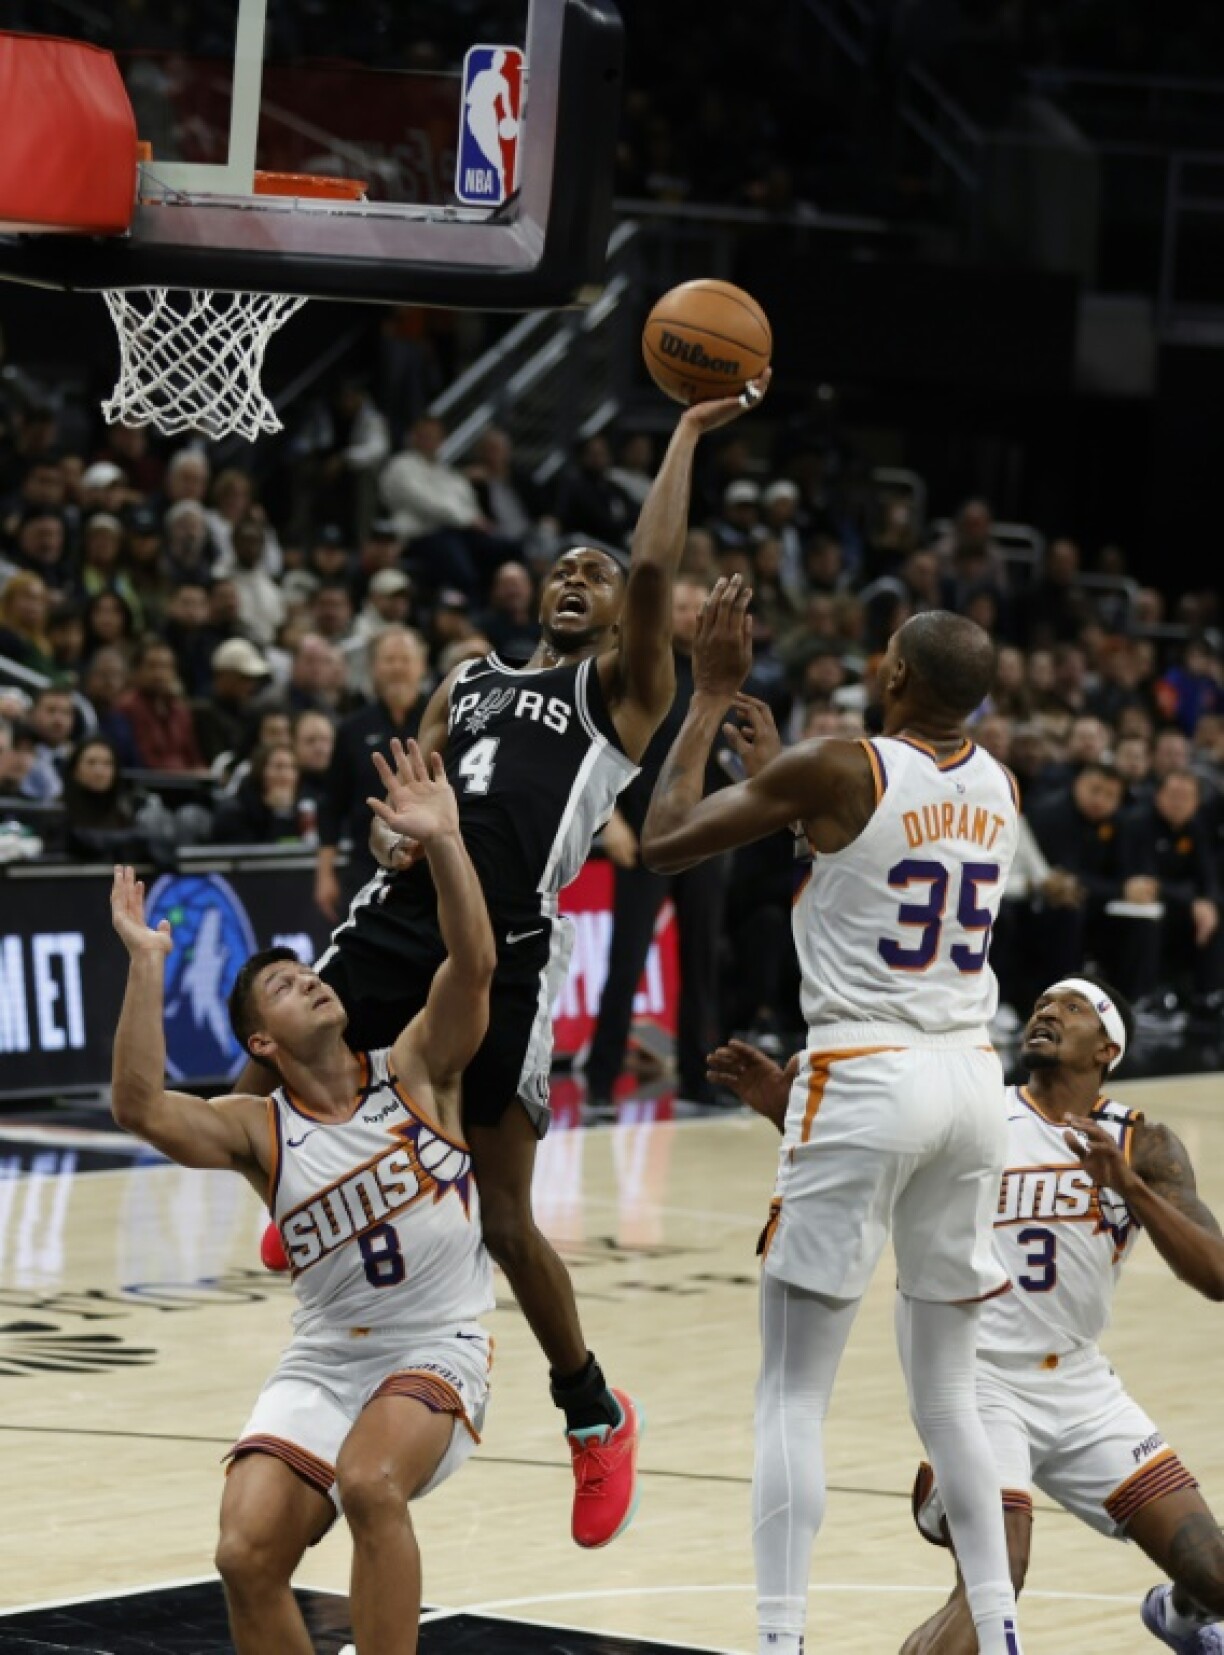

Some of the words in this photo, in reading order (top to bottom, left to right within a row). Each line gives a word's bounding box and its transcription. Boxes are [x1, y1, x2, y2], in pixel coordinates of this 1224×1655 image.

[464, 168, 495, 194] NBA
[660, 330, 740, 376] Wilson
[458, 736, 500, 795] 4
[902, 801, 1005, 851] DURANT
[877, 859, 1000, 975] 35
[357, 1222, 406, 1289] 8
[1016, 1227, 1057, 1293] 3
